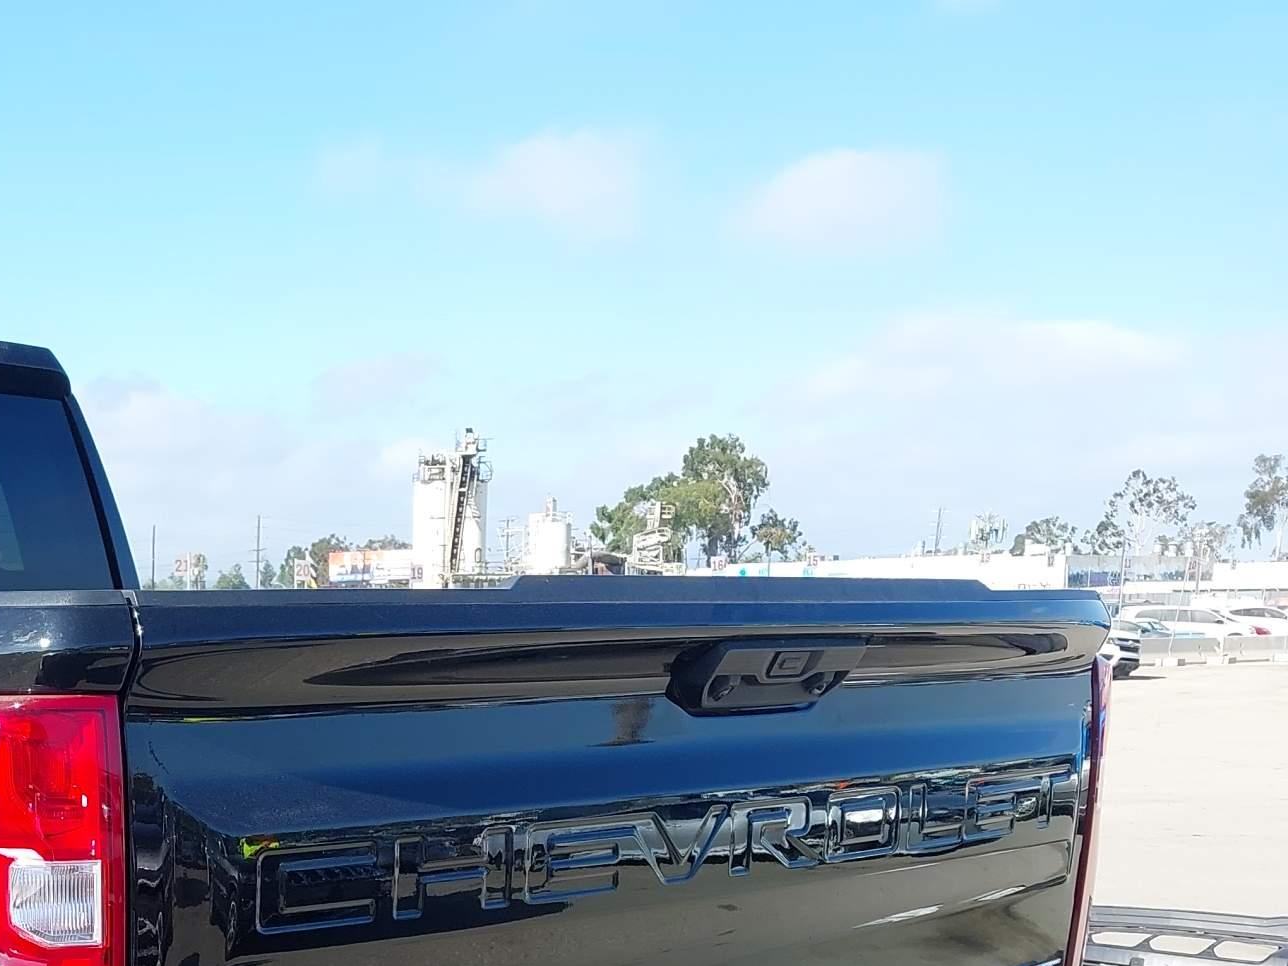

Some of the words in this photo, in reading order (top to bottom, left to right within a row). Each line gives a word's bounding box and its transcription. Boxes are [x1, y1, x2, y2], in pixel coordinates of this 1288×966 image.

[175, 559, 188, 573] 21
[807, 556, 818, 567] 15
[296, 563, 310, 577] 20
[411, 566, 424, 580] 19
[255, 763, 1073, 935] CHEVROLET
